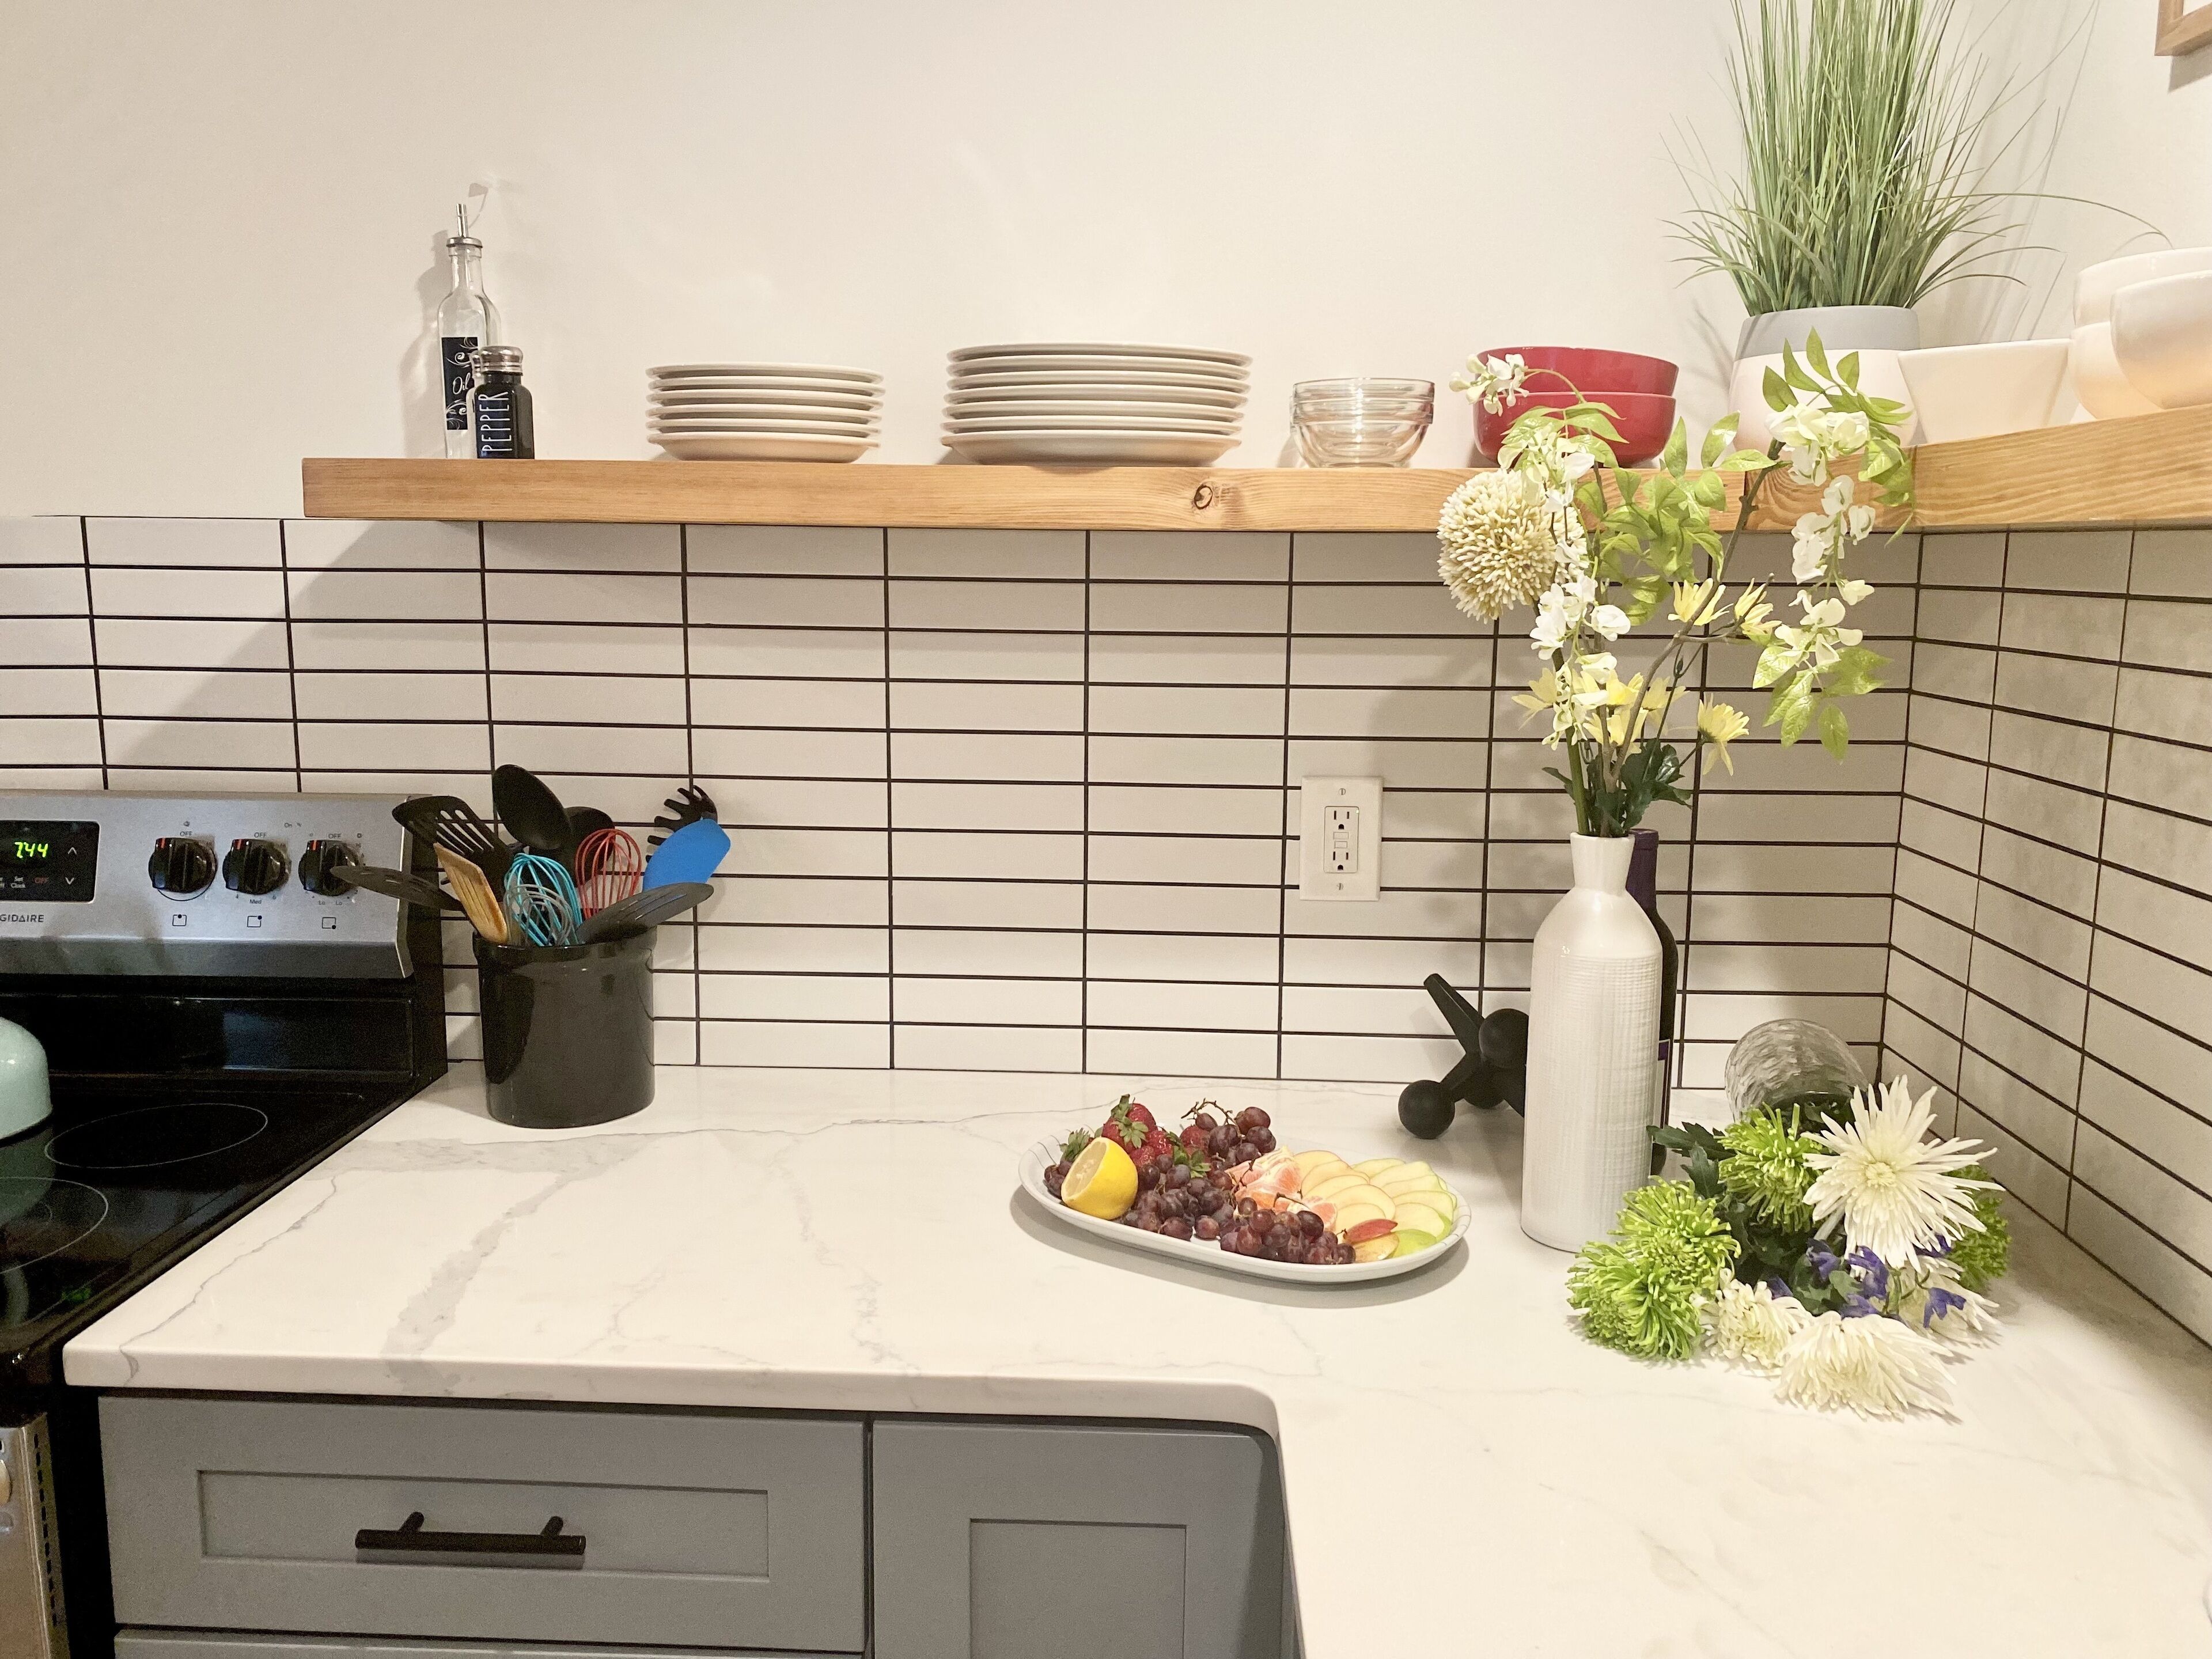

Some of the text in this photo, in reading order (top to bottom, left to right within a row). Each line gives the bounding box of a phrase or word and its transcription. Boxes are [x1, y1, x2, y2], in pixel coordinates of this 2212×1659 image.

[453, 372, 471, 395] Oil
[478, 391, 513, 451] PEPPER
[0, 914, 44, 923] GIDAIRE
